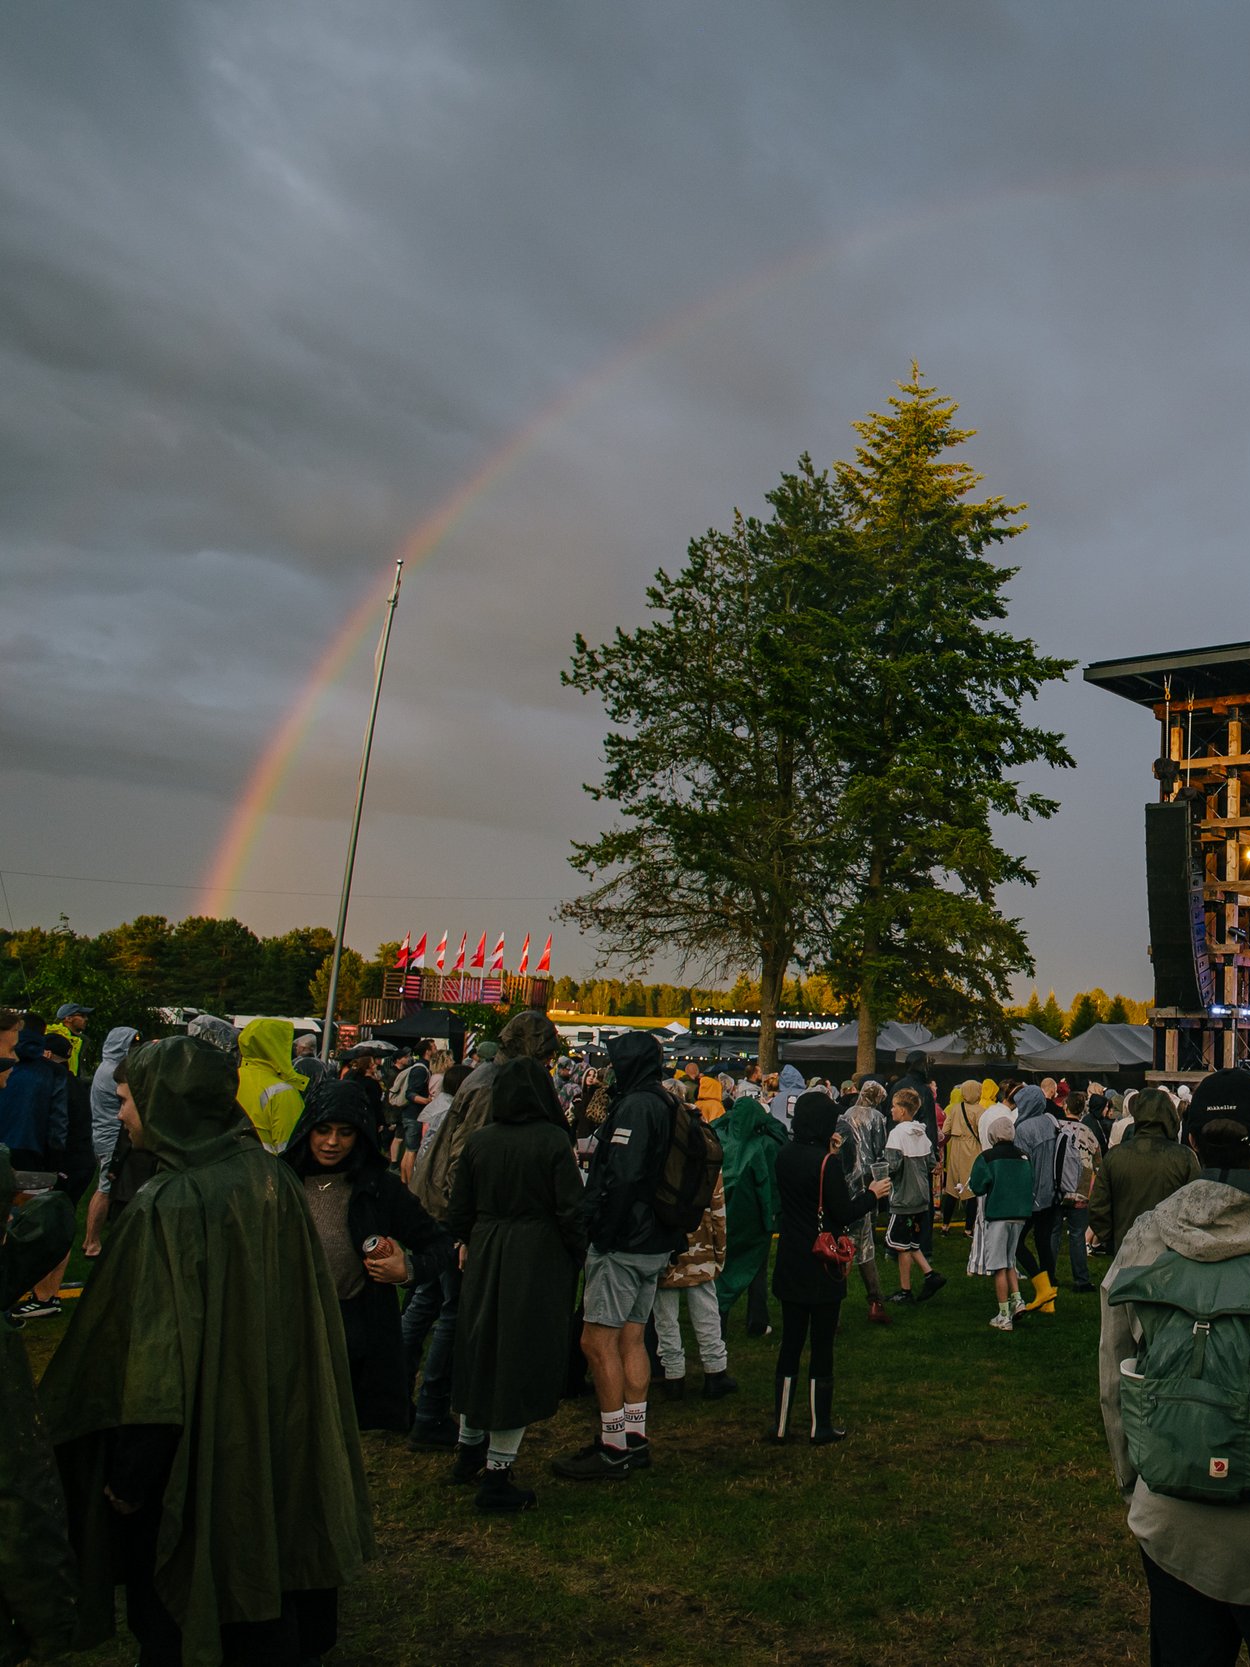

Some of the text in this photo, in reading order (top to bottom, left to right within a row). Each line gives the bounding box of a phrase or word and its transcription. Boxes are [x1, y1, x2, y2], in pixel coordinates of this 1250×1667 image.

[696, 1017, 749, 1027] E-SIGARETID
[751, 1019, 762, 1028] JA
[606, 1421, 624, 1431] SUV
